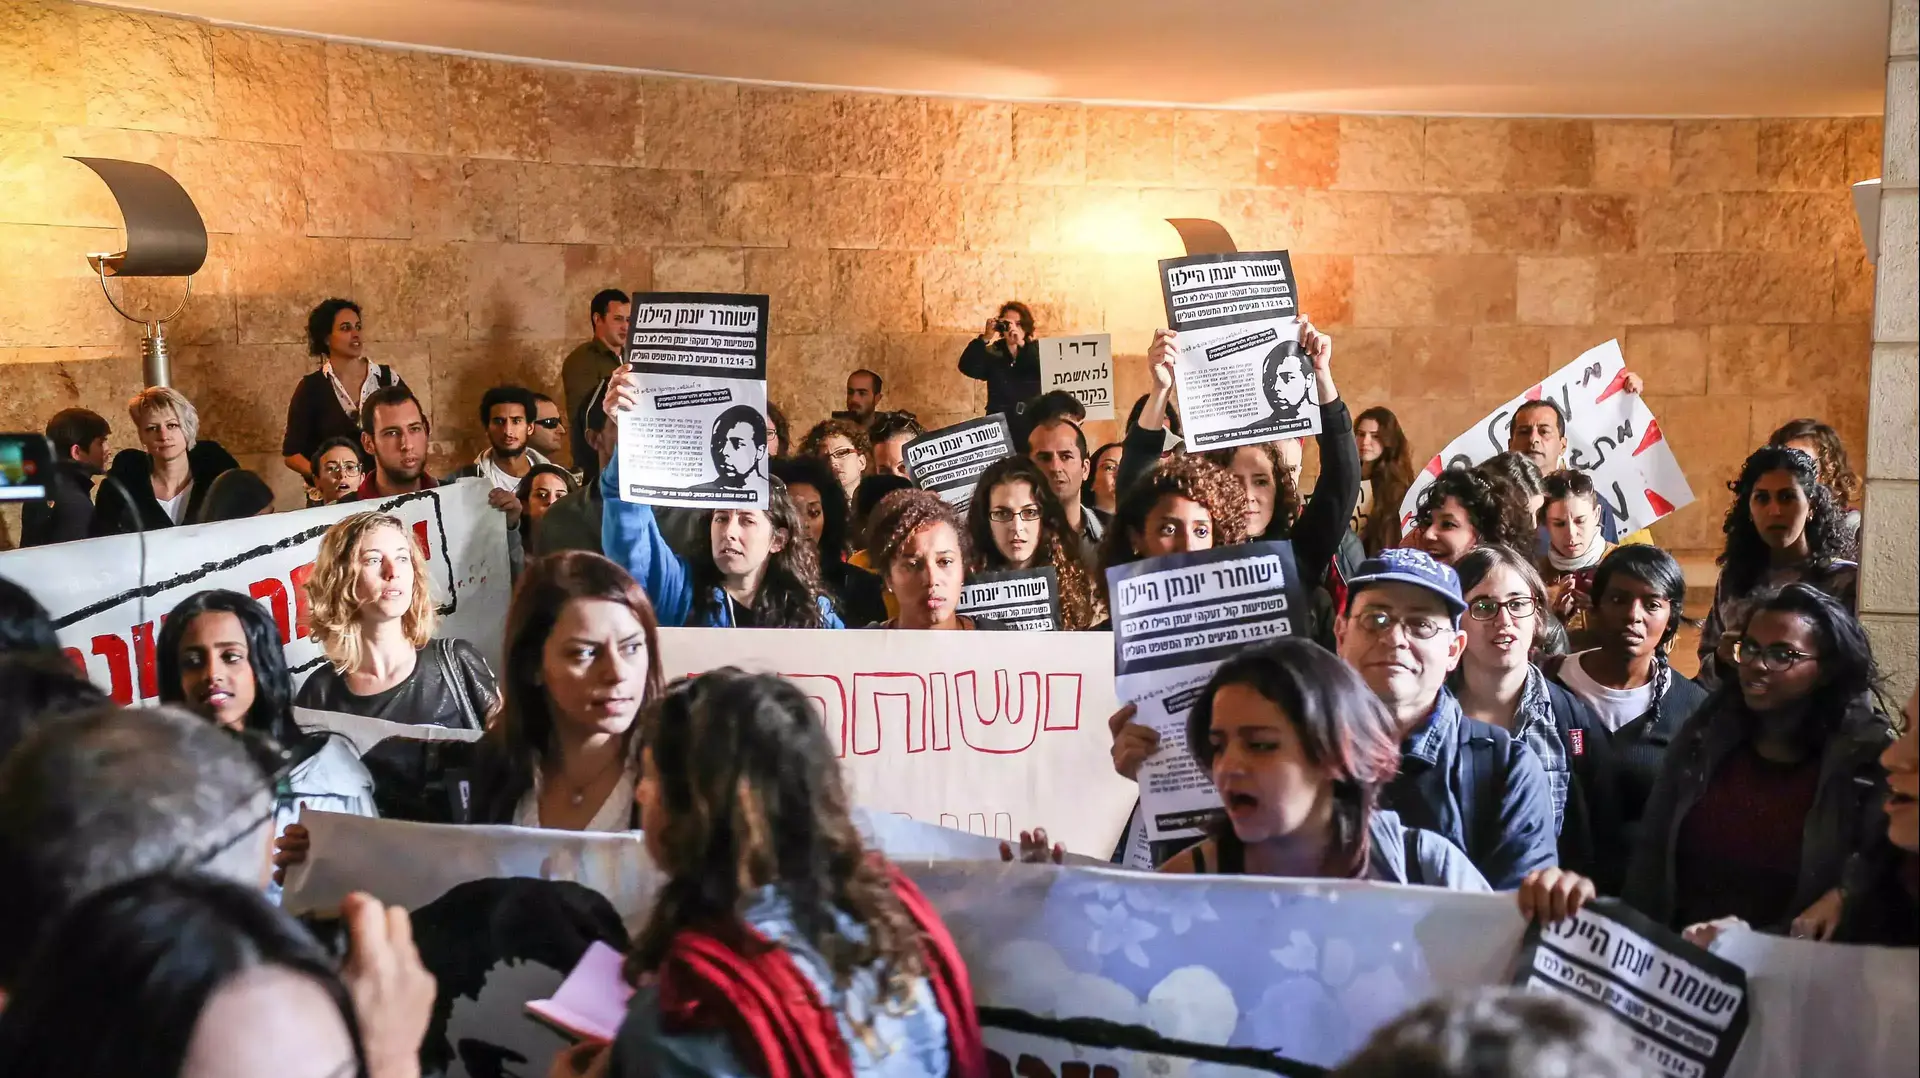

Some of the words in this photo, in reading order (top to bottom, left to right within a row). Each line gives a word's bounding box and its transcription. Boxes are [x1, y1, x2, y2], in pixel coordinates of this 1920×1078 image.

[1210, 266, 1236, 284] יונתן
[1240, 264, 1281, 278] ישוחרר
[1171, 270, 1204, 286] היילו!
[1230, 288, 1248, 297] זעקה!
[1249, 286, 1259, 294] קול
[1260, 284, 1287, 292] משמיעות
[1174, 296, 1189, 304] לבד!
[1190, 294, 1198, 302] לא
[1200, 292, 1214, 300] היילו
[1215, 290, 1229, 299] יונתן
[1222, 304, 1238, 314] לבית
[1238, 302, 1259, 311] מגיעים
[1261, 300, 1290, 308] ב-1.12.14
[638, 306, 672, 324] היילו!
[674, 308, 704, 326] יונתן
[710, 309, 756, 326] ישוחרר
[1177, 310, 1196, 320] העליון
[1198, 307, 1221, 317] המשפט
[635, 334, 648, 342] לבד!
[649, 334, 658, 343] לא
[658, 334, 672, 344] היילו
[673, 336, 688, 346] יונתן
[690, 336, 708, 346] זעקה!
[710, 336, 722, 347] קול
[724, 340, 754, 348] משמיעות
[1209, 335, 1276, 359] freeyonatan.wordpress.com
[631, 351, 649, 360] העליון
[651, 352, 676, 361] המשפט
[678, 354, 694, 362] לבית
[695, 356, 718, 364] מגיעים
[720, 357, 754, 366] ב-1.12.14
[1052, 362, 1108, 385] להאשמת
[657, 395, 730, 407] freeyonatan.wordpress.com
[1068, 388, 1107, 404] הקורב
[966, 426, 1000, 444] ישוחרר
[940, 436, 963, 455] יונתן
[910, 444, 937, 462] היילו!
[935, 472, 955, 482] המשפט
[956, 469, 968, 478] לבית
[1212, 562, 1277, 589] ישוחרר
[1003, 582, 1045, 598] ישוחרר
[1164, 573, 1205, 602] יונתן
[972, 587, 999, 605] יונתן
[1121, 581, 1159, 607] היילו!
[1022, 606, 1048, 616] משמיעות
[1223, 604, 1238, 617] קול
[1242, 598, 1283, 614] משמיעות
[1173, 613, 1192, 627] יונתן
[1195, 609, 1220, 622] זעקה!
[1139, 620, 1148, 630] לא
[1152, 617, 1170, 628] היילו
[1241, 622, 1287, 637] ב-1.12.14
[1184, 634, 1205, 647] לבית
[1208, 630, 1238, 644] מגיעים
[1149, 639, 1182, 652] המשפט
[688, 669, 1082, 758] ישוחר
[1612, 938, 1654, 977] יונתן
[1658, 962, 1736, 1016] ישוחרר
